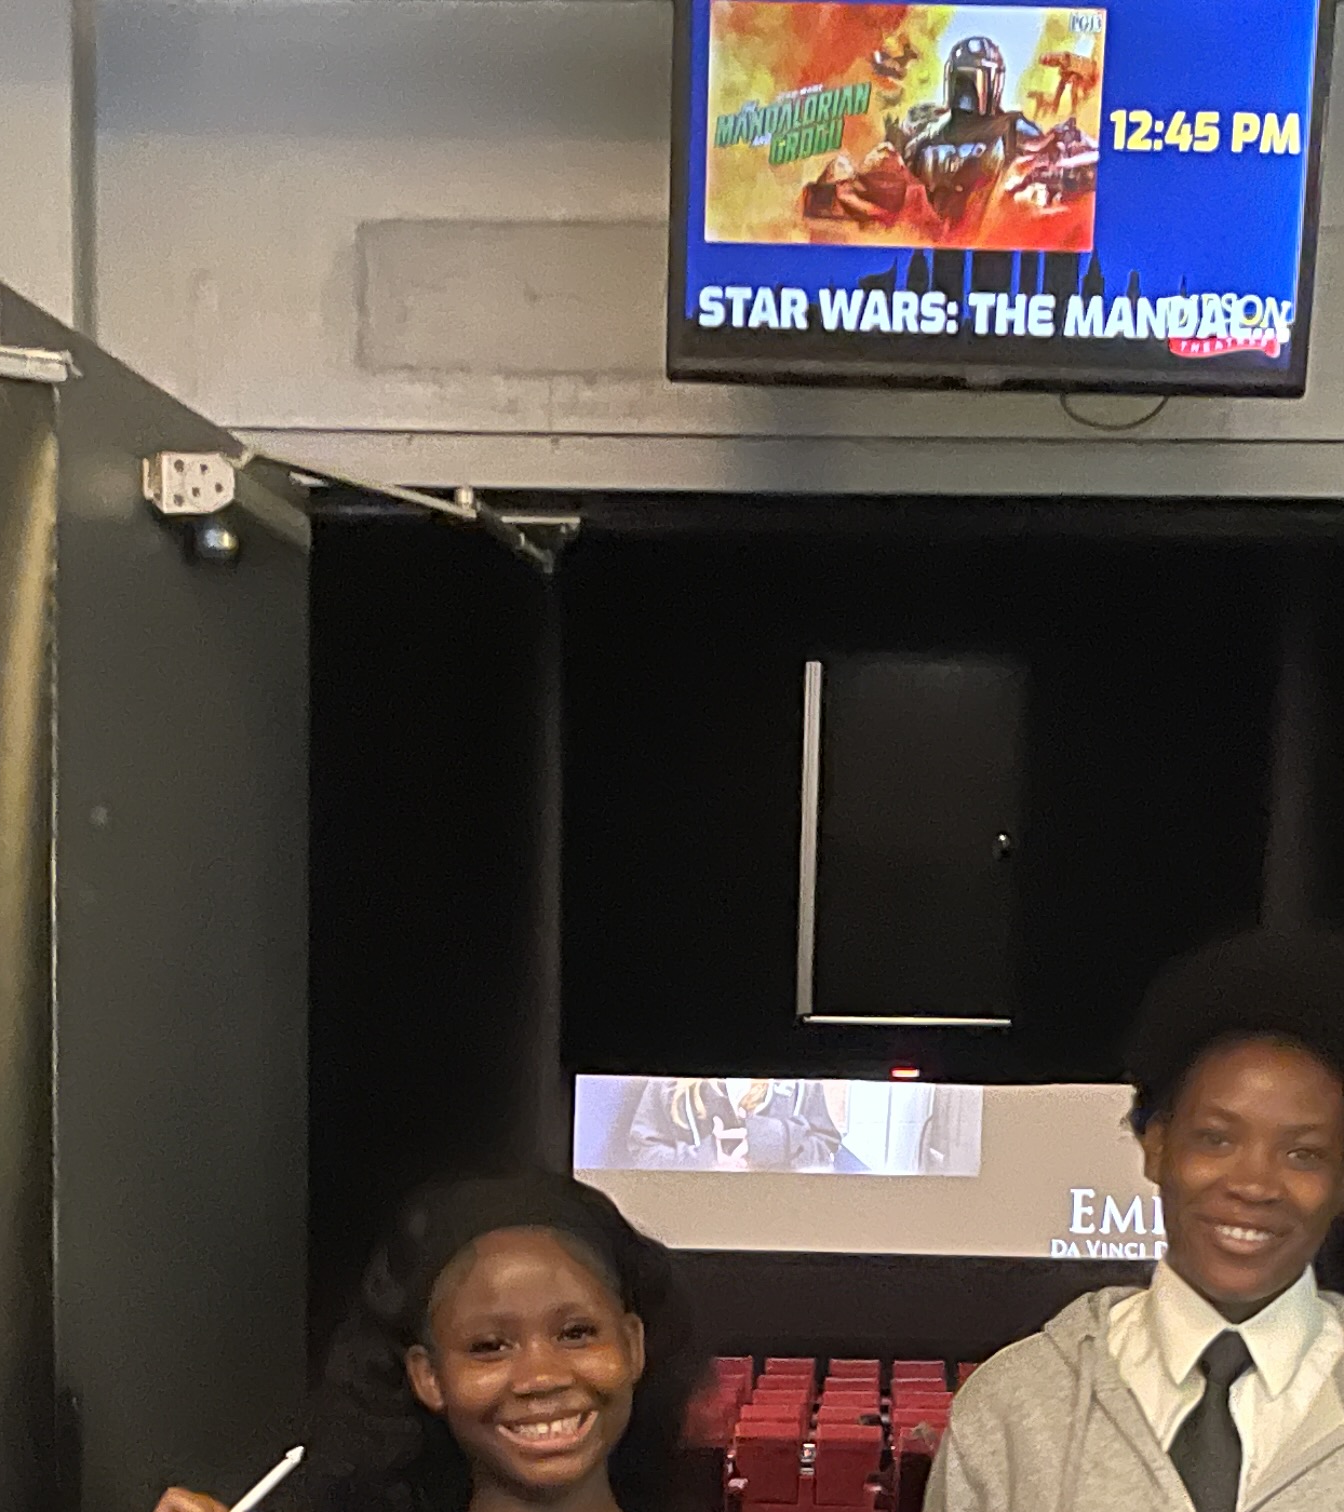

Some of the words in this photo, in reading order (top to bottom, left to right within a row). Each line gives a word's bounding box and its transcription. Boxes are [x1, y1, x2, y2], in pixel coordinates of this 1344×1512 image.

[714, 82, 871, 149] MANDALORIAN
[1109, 109, 1219, 152] 12:45
[1231, 111, 1301, 156] PM
[698, 286, 809, 330] STAR
[820, 289, 958, 334] WARS:
[966, 293, 1055, 337] THE
[1085, 1239, 1147, 1259] VINCI
